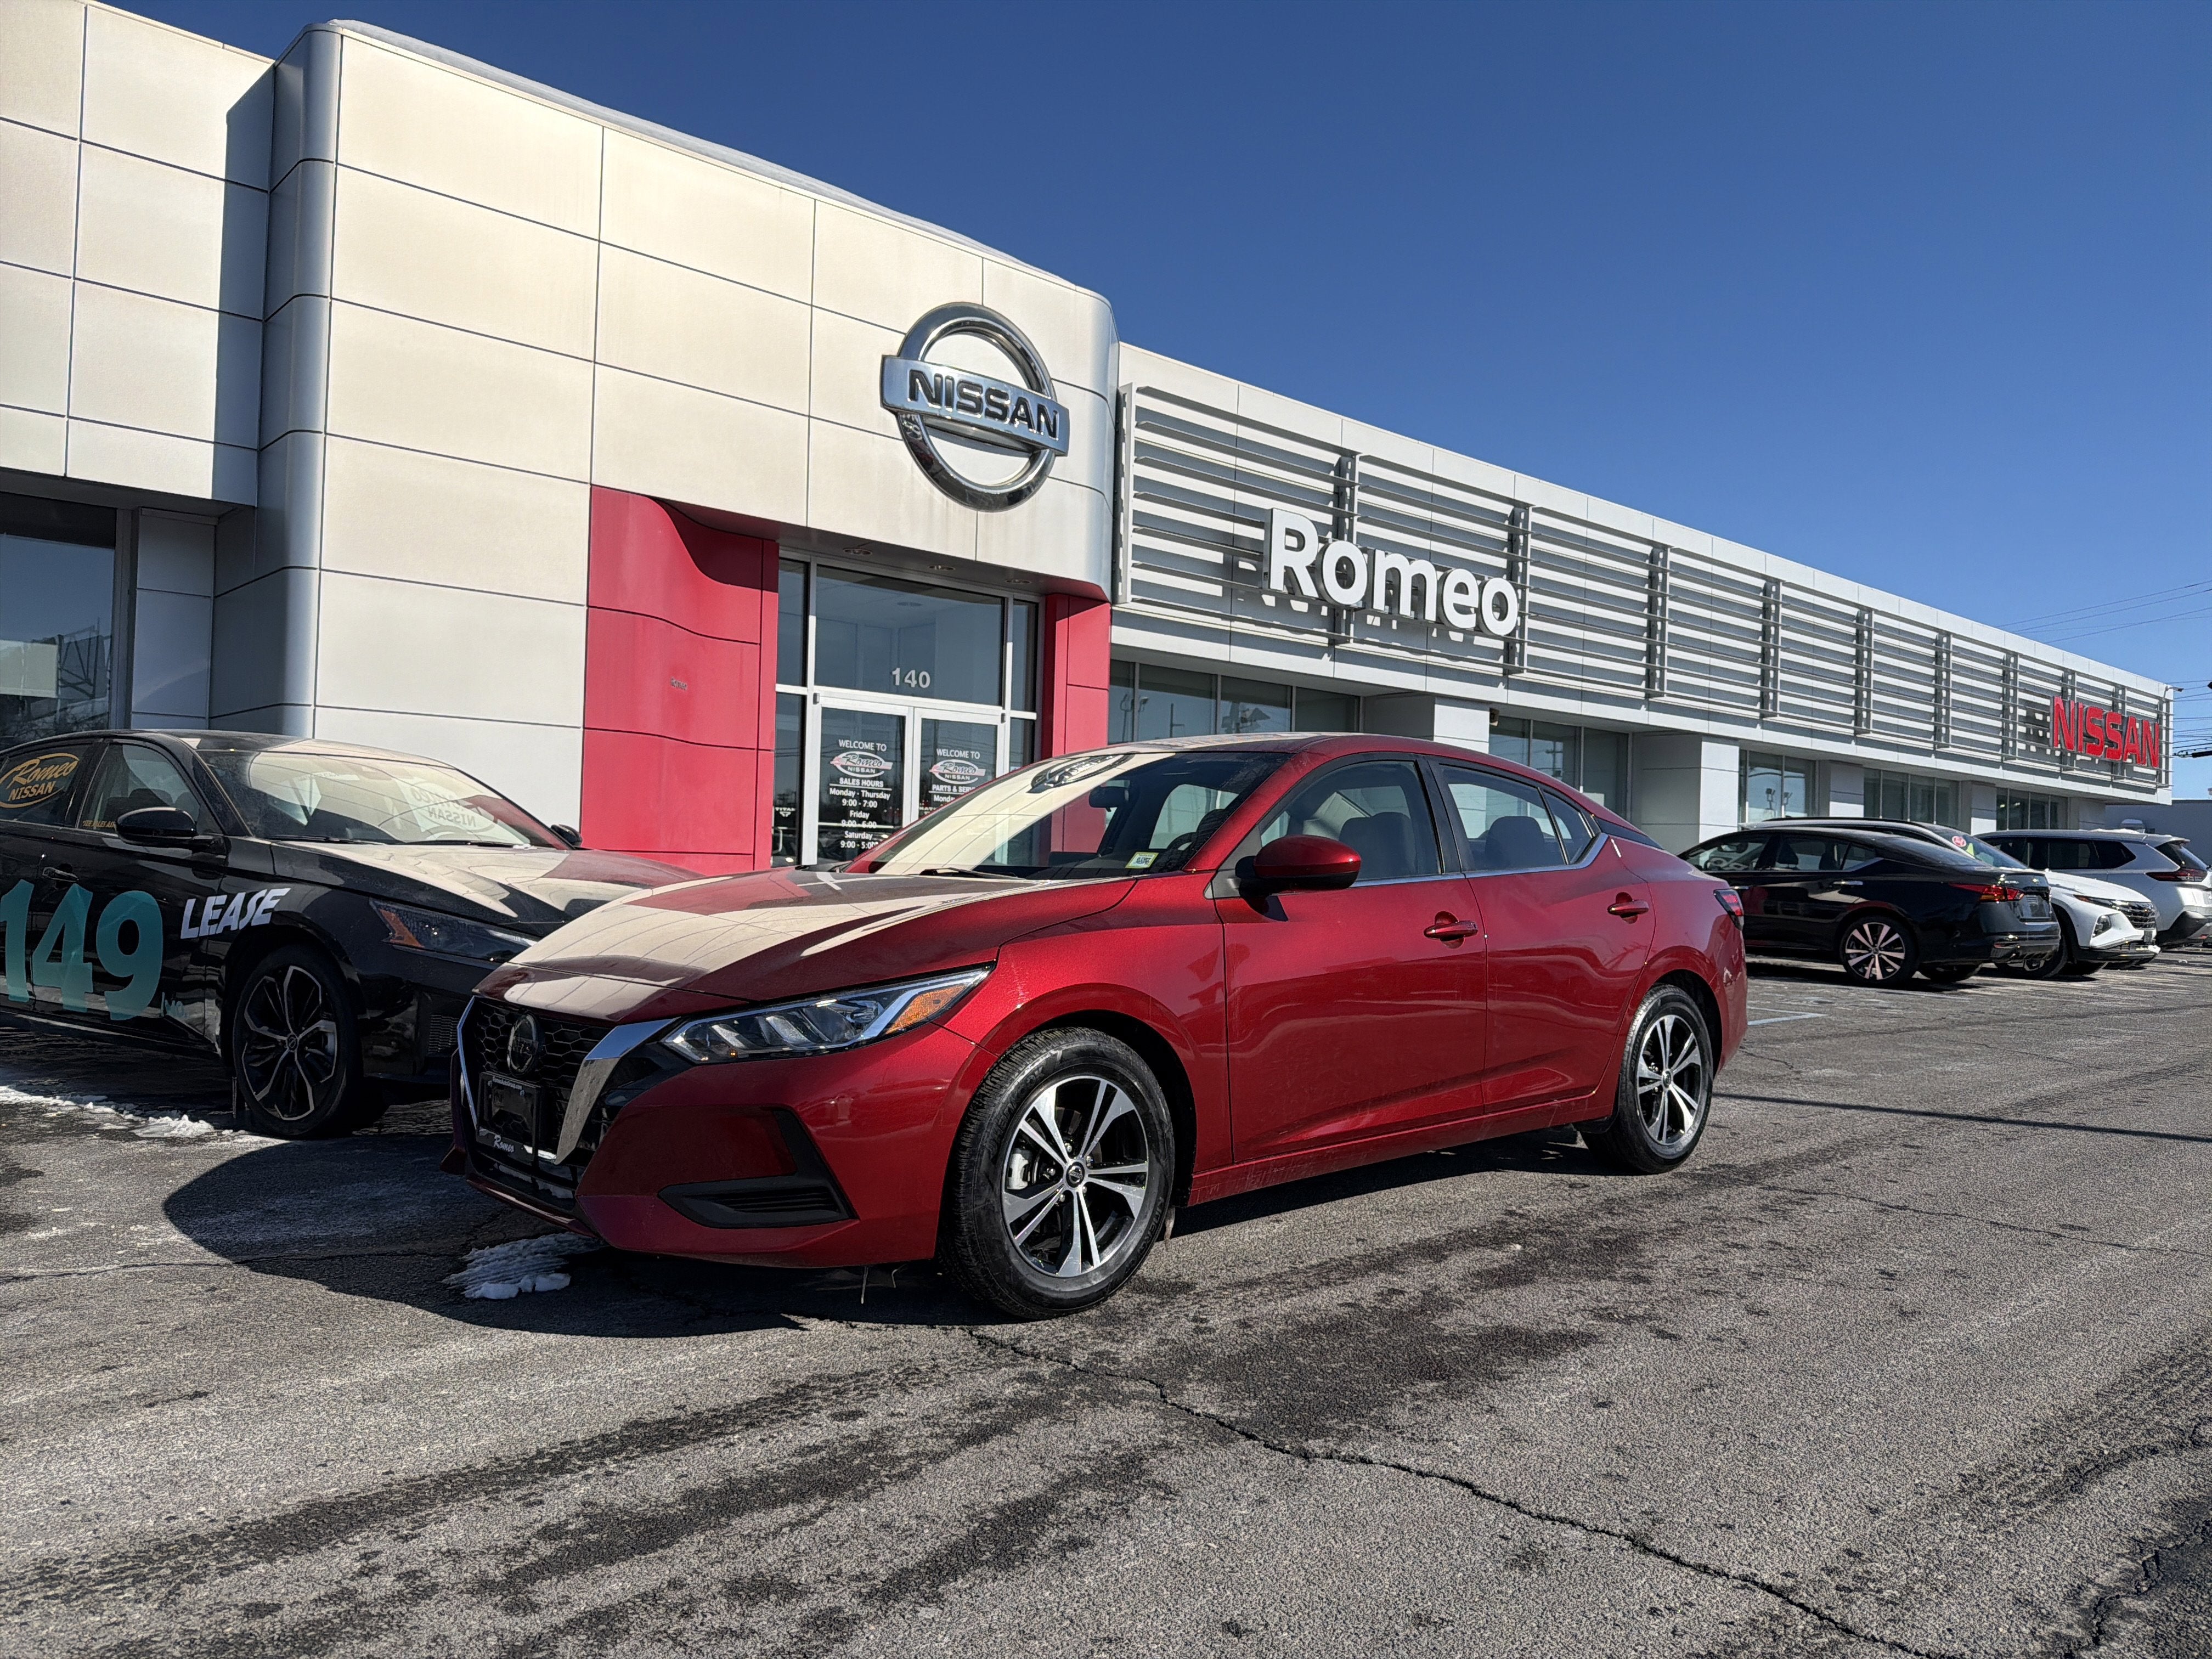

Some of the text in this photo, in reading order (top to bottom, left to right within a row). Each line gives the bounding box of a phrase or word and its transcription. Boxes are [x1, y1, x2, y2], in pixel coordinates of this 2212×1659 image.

[907, 369, 1059, 441] NISSAN
[1268, 507, 1519, 637] Romeo
[892, 668, 930, 688] 140
[2053, 696, 2160, 768] NISSAN
[839, 739, 887, 752] WELCOME TO
[936, 748, 980, 759] WELCOME TO
[842, 753, 883, 767] Romeo
[943, 761, 977, 774] Romeo
[5, 759, 79, 789] Romeo
[839, 777, 884, 788] SALES HOURS
[8, 781, 56, 802] NISSAN
[830, 788, 856, 798] Monday
[861, 790, 891, 800] Thursday
[842, 799, 857, 807] 9:00
[863, 800, 878, 808] 7:00
[850, 810, 870, 819] Friday
[845, 831, 873, 840] Saturday
[180, 888, 291, 939] LEASE
[0, 879, 164, 1020] 149
[493, 1135, 514, 1153] Romeo
